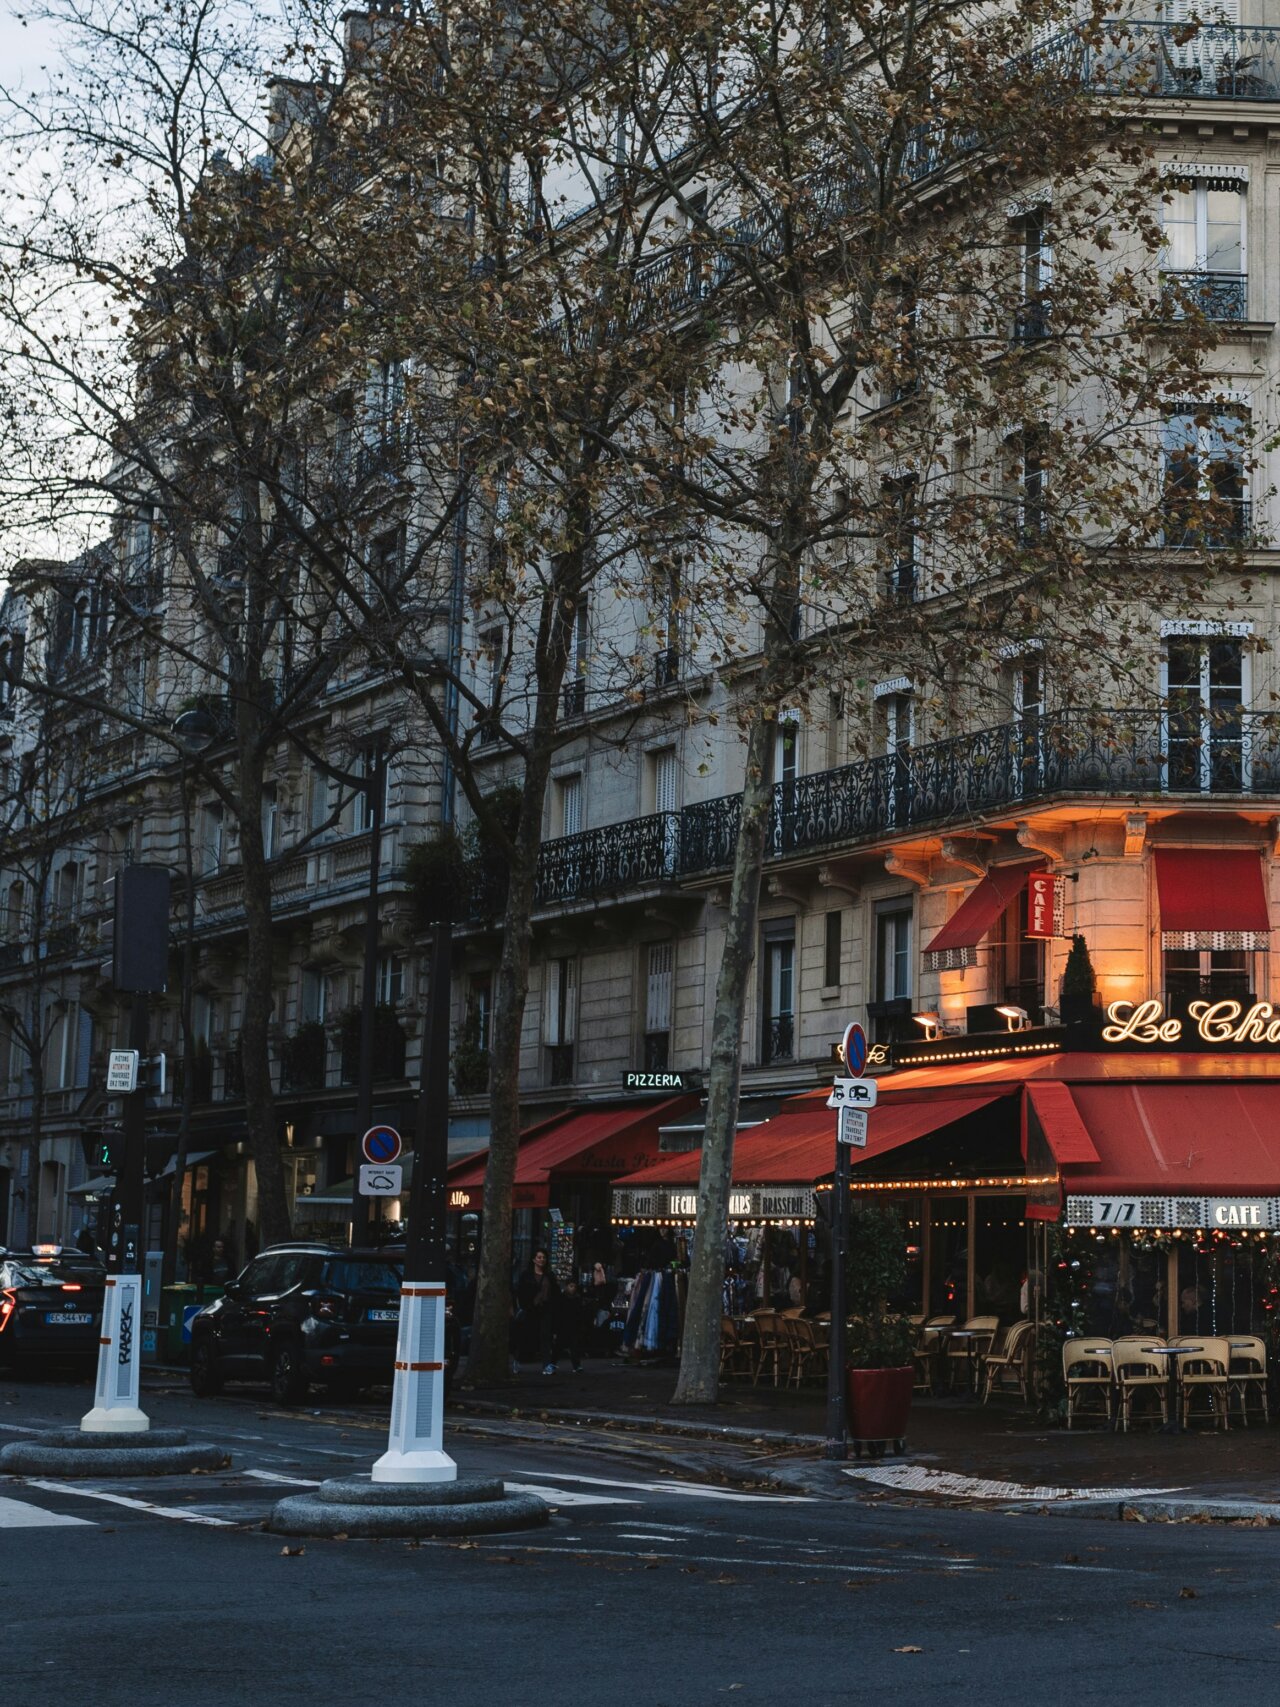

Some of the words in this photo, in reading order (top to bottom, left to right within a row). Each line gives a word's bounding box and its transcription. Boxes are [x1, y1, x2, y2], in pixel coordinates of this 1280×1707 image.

[1102, 1000, 1182, 1042] Le
[627, 1073, 682, 1087] PIZZERIA
[670, 1195, 680, 1214] LE
[762, 1196, 804, 1215] BRASSERIE
[1099, 1202, 1136, 1224] 7/7
[1215, 1205, 1261, 1226] CAFE
